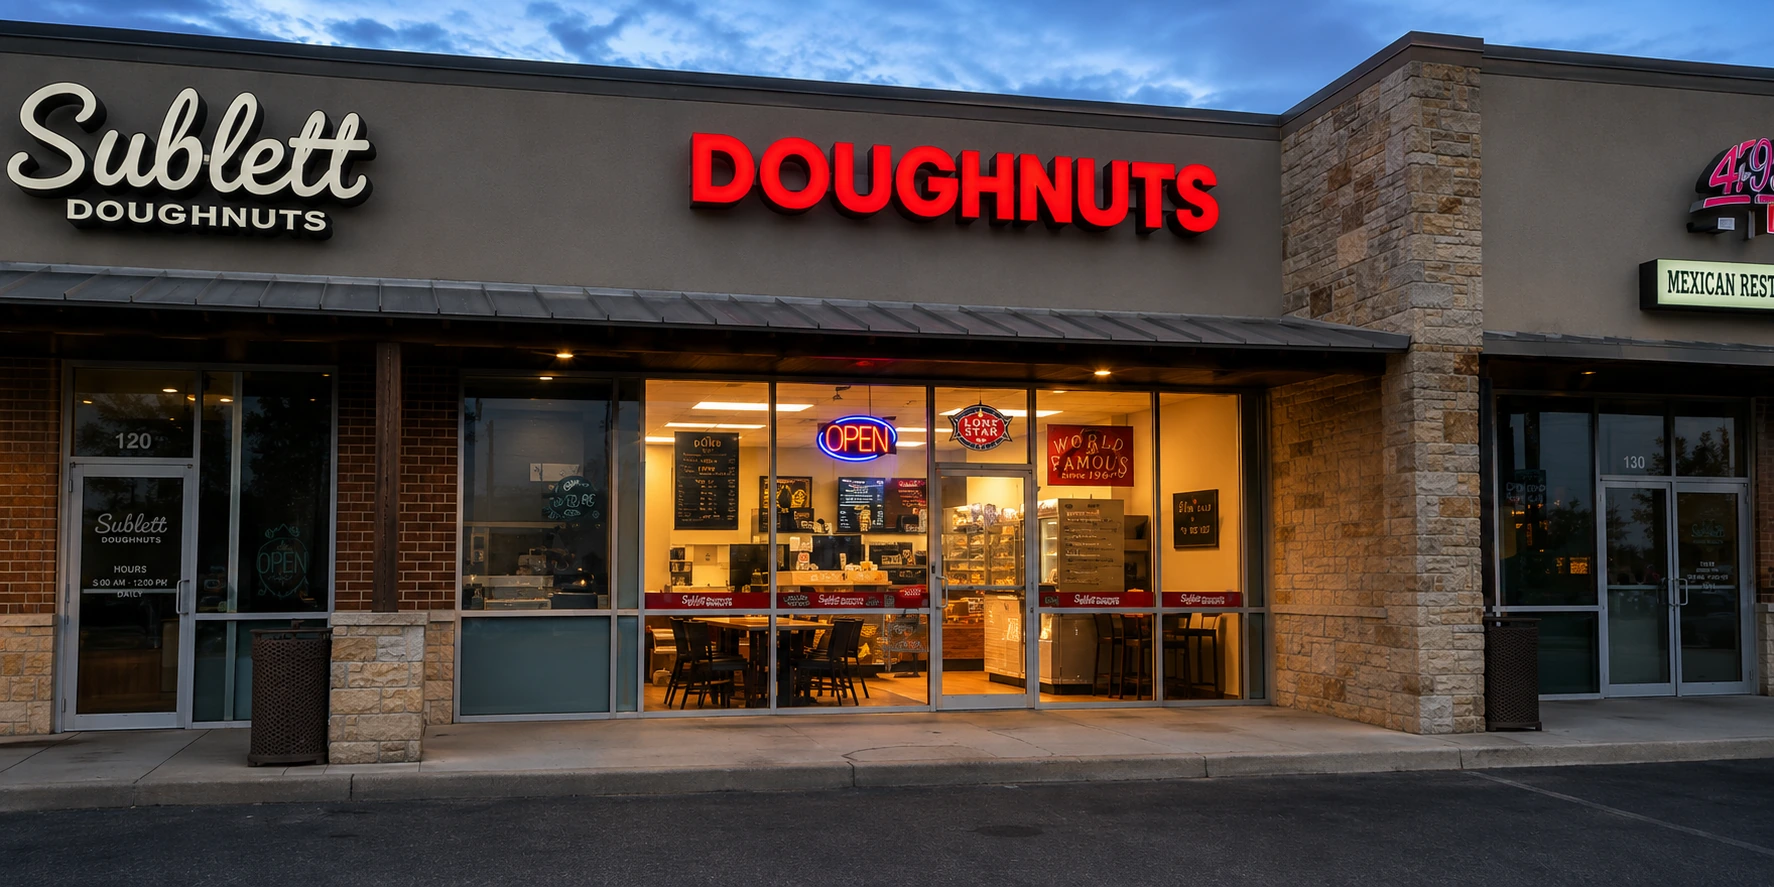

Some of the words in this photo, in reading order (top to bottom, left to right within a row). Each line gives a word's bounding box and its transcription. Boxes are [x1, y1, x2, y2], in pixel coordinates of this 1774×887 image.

[7, 82, 371, 200] Sublett
[690, 132, 1220, 234] DOUGHNUTS
[66, 198, 328, 232] DOUGHNUTS
[1667, 269, 1736, 297] MEXICAN
[115, 432, 152, 450] 120
[825, 424, 889, 453] OPEN
[964, 427, 998, 437] STAR
[1053, 433, 1124, 454] WORLD
[1050, 454, 1129, 479] FAMOUS
[1623, 455, 1646, 469] 130
[94, 513, 168, 534] Sublett
[101, 536, 162, 544] DOUGHNUTS
[113, 565, 147, 574] HOURS
[258, 551, 308, 575] OPEN
